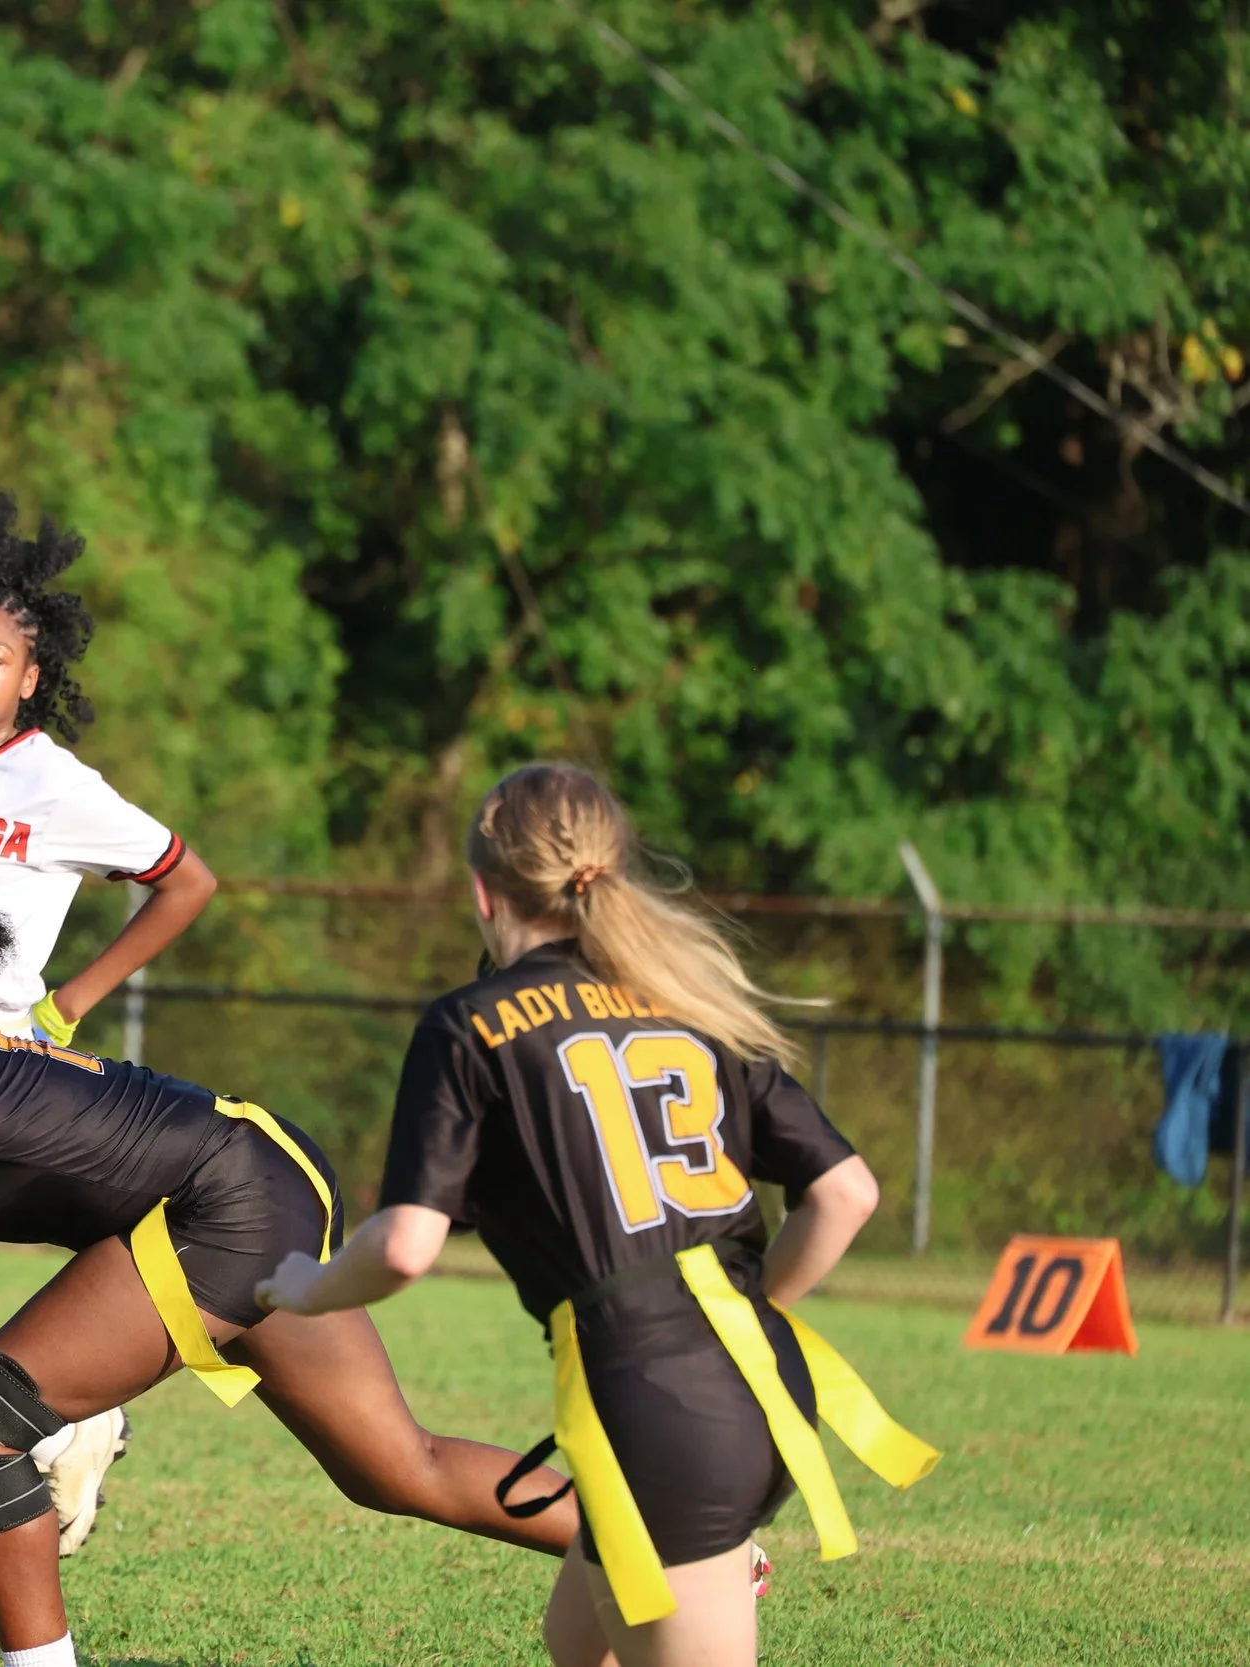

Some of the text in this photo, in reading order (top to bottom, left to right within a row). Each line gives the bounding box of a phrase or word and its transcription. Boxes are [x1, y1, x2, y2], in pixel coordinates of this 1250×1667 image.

[471, 983, 573, 1049] LADY
[556, 1031, 753, 1234] 13
[986, 1255, 1084, 1334] 10
